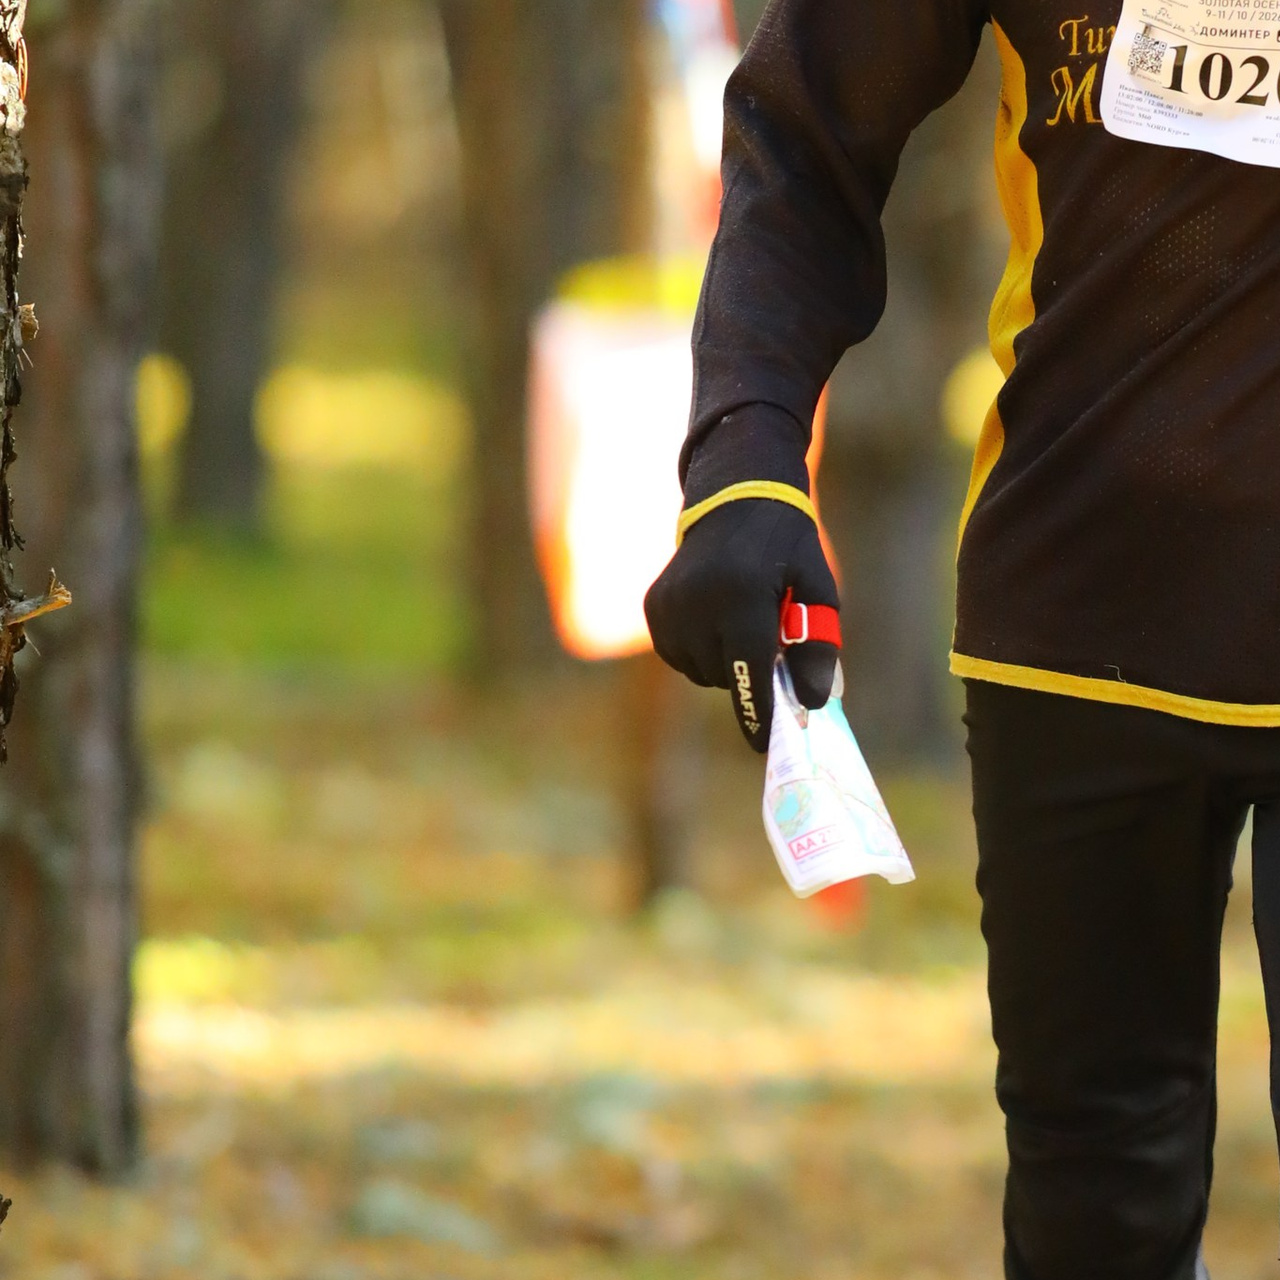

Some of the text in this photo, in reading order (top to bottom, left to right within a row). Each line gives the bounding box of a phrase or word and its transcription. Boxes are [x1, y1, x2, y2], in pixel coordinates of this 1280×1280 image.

[1199, 26, 1271, 40] ДОМИНТЕР
[1205, 9, 1226, 19] 9-11
[1237, 10, 1248, 20] 10
[1046, 62, 1104, 126] M
[733, 660, 758, 721] CRAFT
